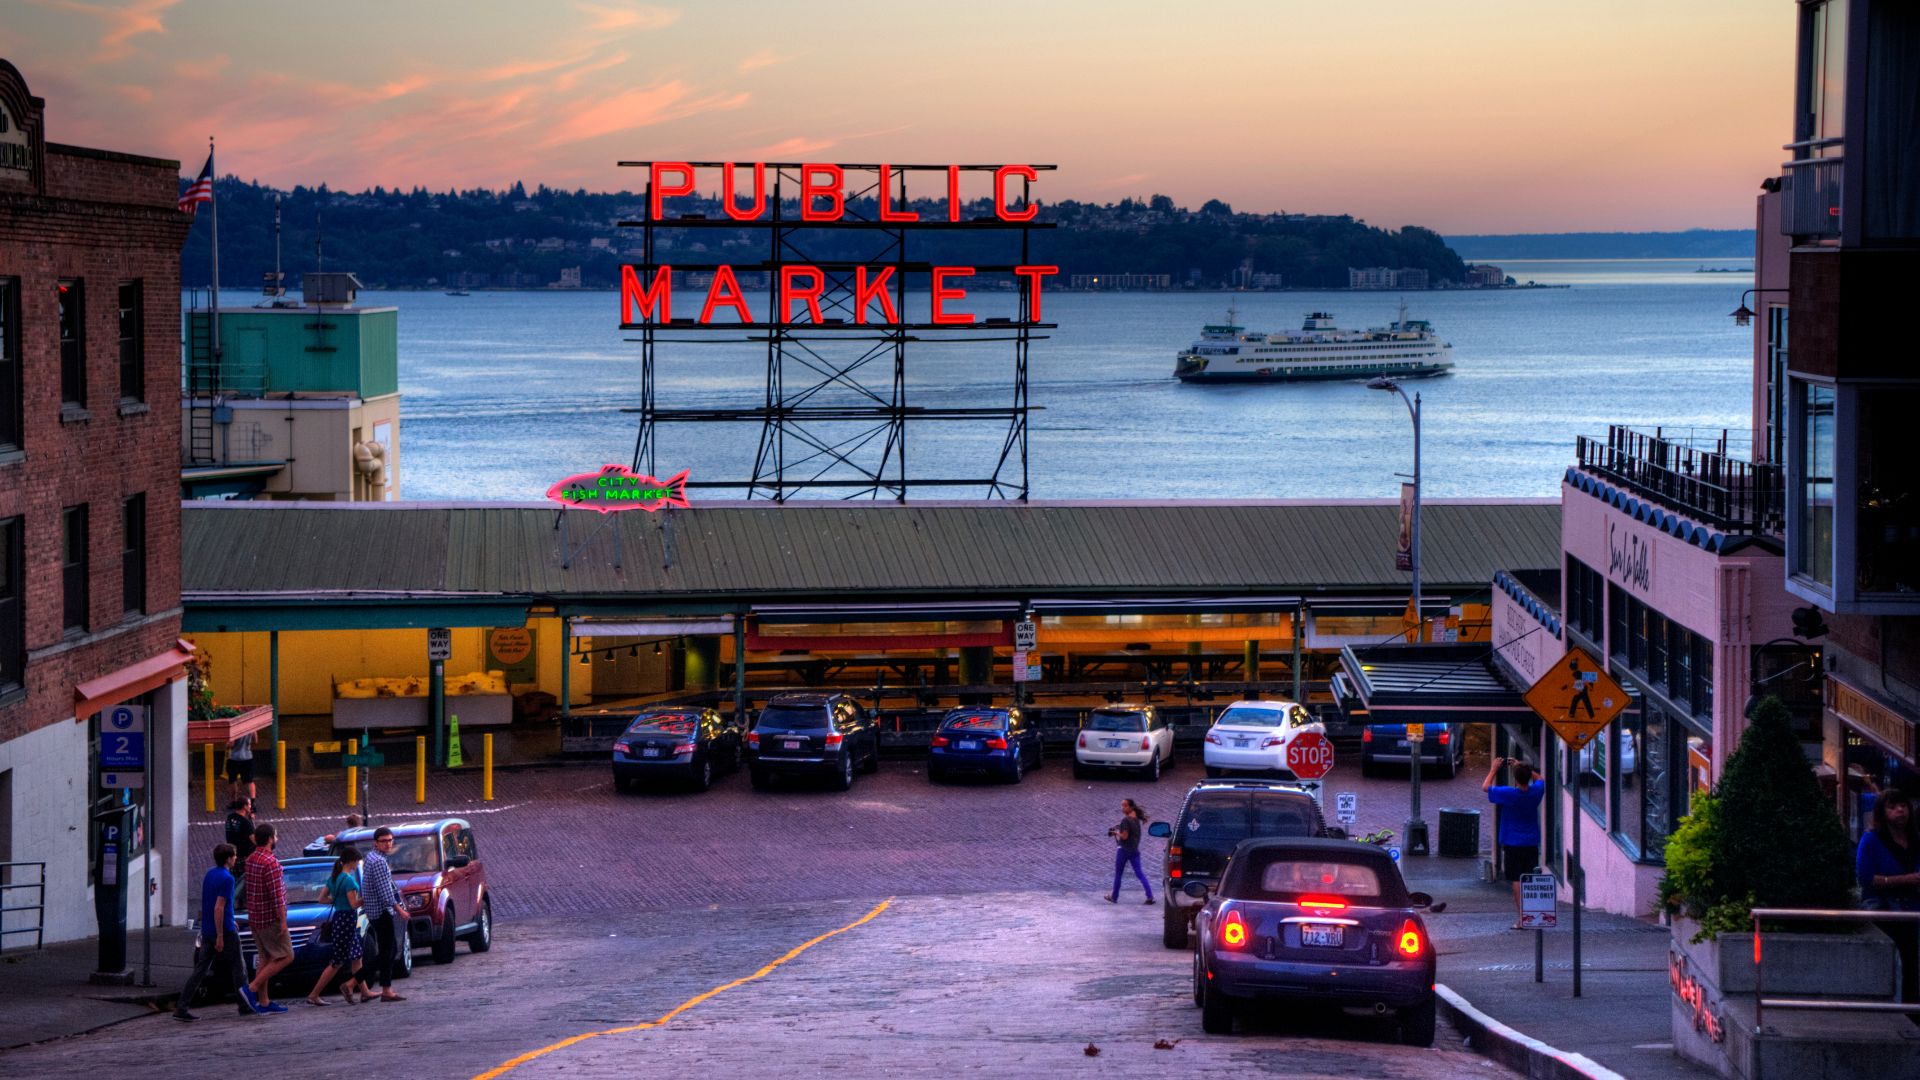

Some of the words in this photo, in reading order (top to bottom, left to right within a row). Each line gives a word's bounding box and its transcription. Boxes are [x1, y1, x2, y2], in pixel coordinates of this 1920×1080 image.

[651, 161, 1038, 222] PUBLIC
[621, 264, 1059, 325] MARKET
[597, 477, 639, 488] CITY
[561, 488, 599, 500] FISH
[605, 488, 673, 501] MARKET
[1623, 531, 1632, 584] La
[1632, 533, 1650, 593] Table
[118, 712, 129, 725] P
[115, 736, 130, 754] 2
[1290, 747, 1329, 764] STOP
[109, 825, 118, 840] P
